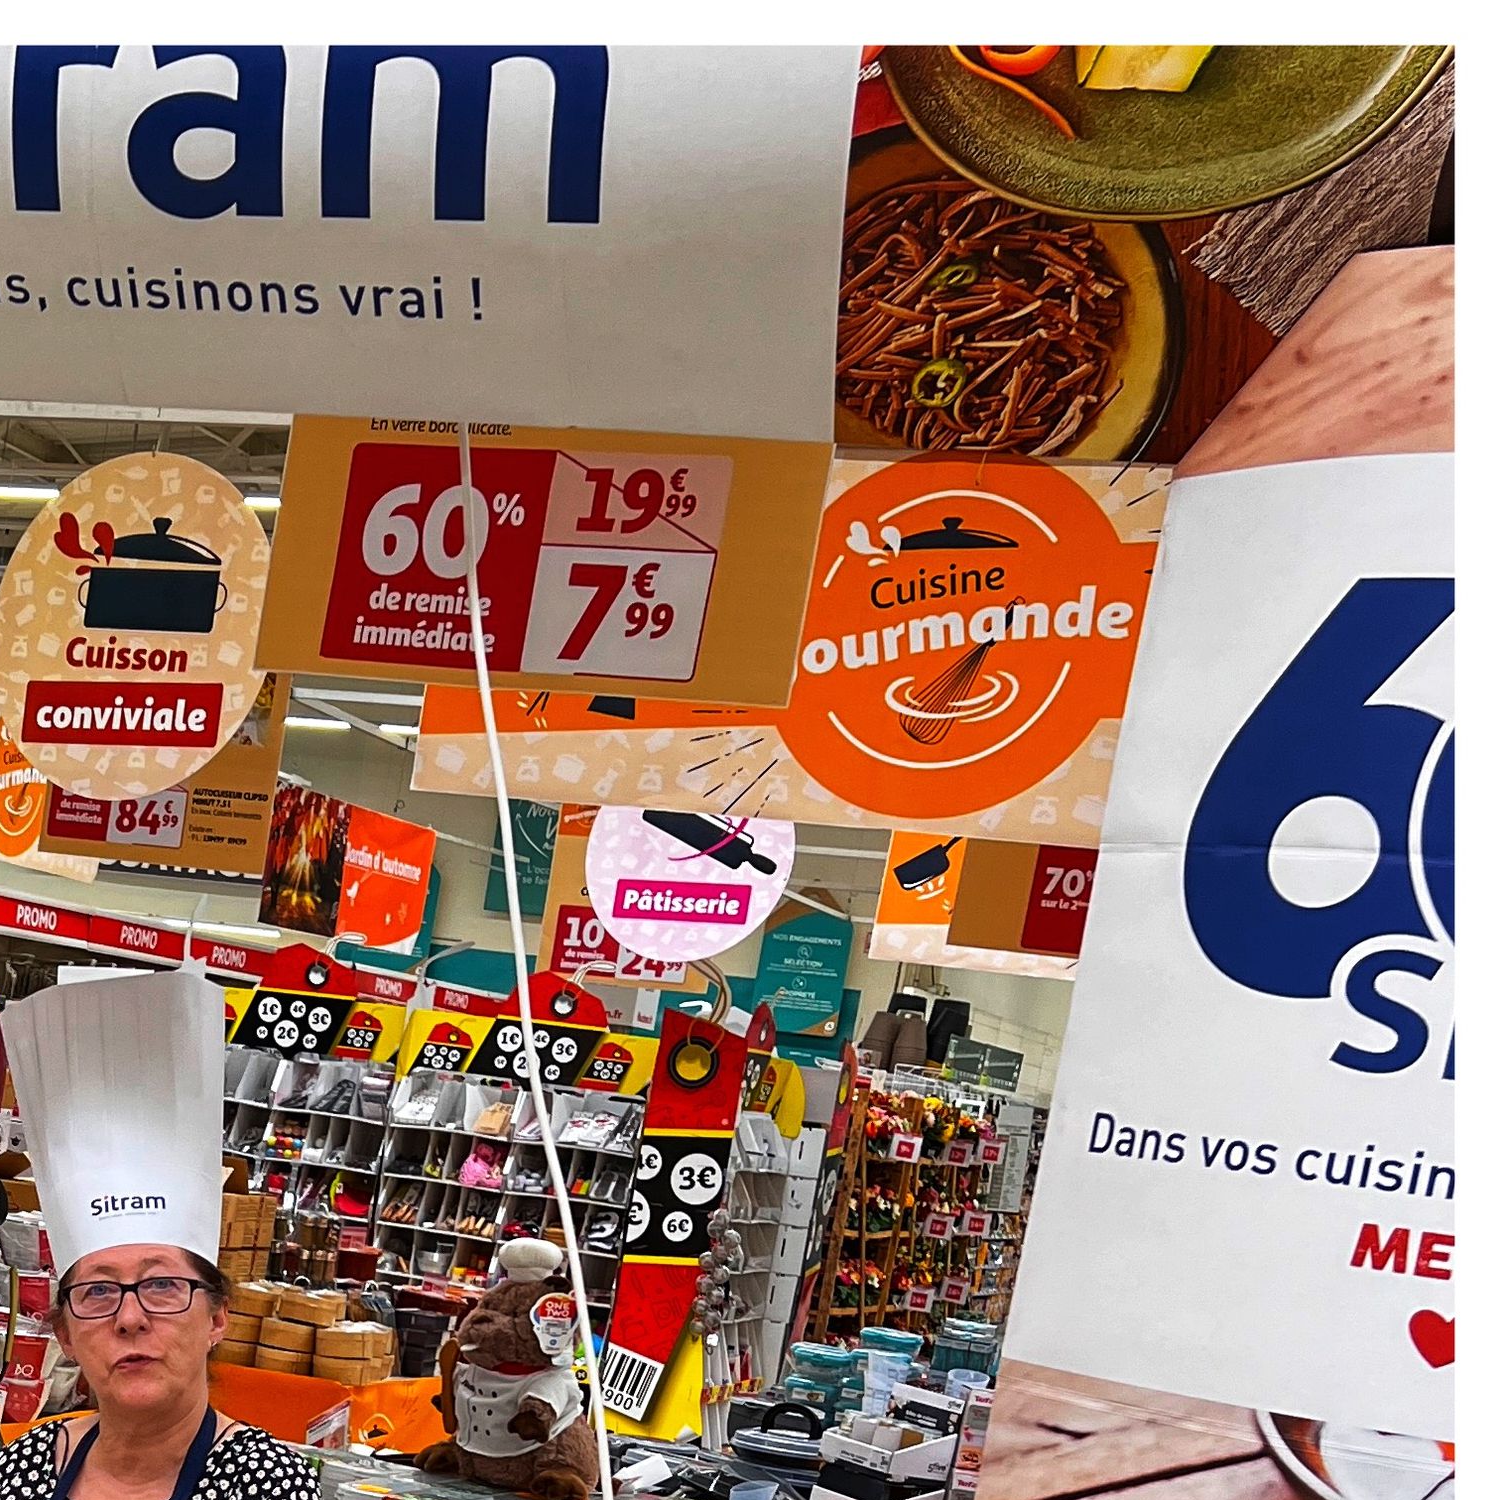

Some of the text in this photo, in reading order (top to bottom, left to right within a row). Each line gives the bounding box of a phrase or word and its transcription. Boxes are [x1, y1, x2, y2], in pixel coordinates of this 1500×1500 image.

[66, 266, 320, 315] cuisinons
[339, 276, 444, 320] vrai
[471, 278, 484, 320] !
[369, 583, 402, 612] de
[870, 563, 1006, 609] Cuisine
[353, 615, 496, 653] immédiae
[65, 636, 190, 675] Cuisson
[36, 685, 207, 733] conviviale
[622, 888, 741, 918] Pâtisserie
[15, 904, 58, 930] PROMO
[119, 924, 158, 950] PROMO
[211, 945, 247, 969] PROMO
[373, 977, 403, 998] PROMO
[260, 1002, 278, 1016] 1€
[311, 1013, 329, 1025] 3€
[276, 1026, 296, 1040] 2€
[501, 1032, 519, 1045] 1€
[555, 1043, 575, 1056] 3€
[1088, 1111, 1185, 1165] Dans
[1202, 1135, 1278, 1176] vos
[678, 1166, 716, 1191] 3€
[90, 1195, 166, 1217] Sitram
[666, 1218, 690, 1233] 6€
